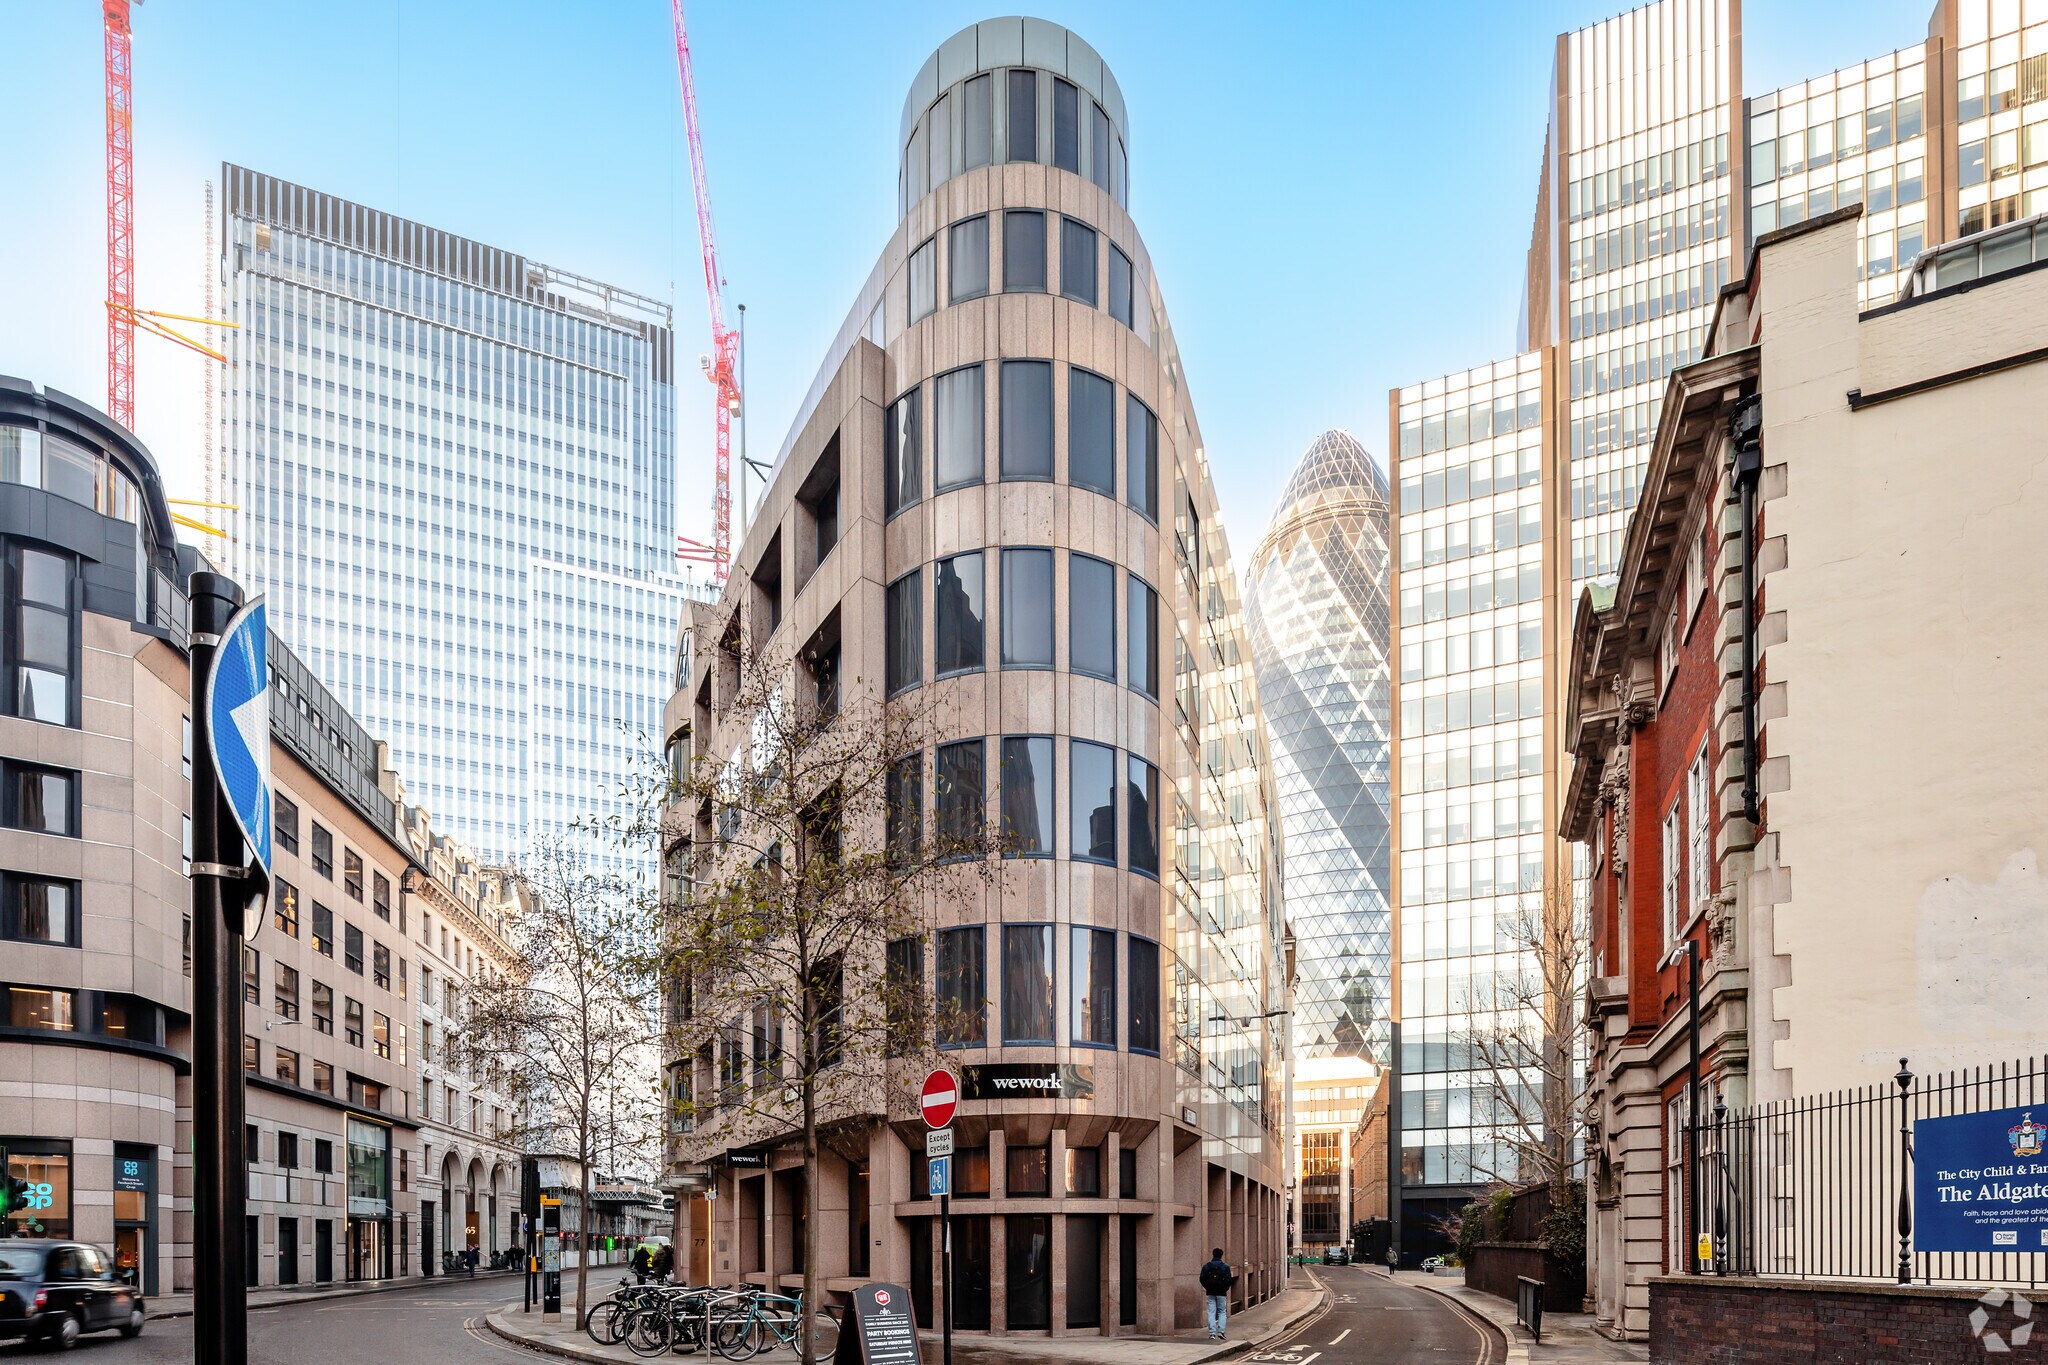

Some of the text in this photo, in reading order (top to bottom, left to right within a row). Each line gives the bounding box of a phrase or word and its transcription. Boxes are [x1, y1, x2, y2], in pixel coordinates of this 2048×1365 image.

[993, 1073, 1063, 1089] wework
[929, 1133, 950, 1143] Except
[929, 1143, 950, 1153] cycles
[731, 1155, 761, 1163] wework
[1937, 1170, 1957, 1181] The
[1959, 1169, 1981, 1181] City
[1983, 1166, 2013, 1177] Child
[2016, 1164, 2027, 1175] &
[1938, 1182, 2048, 1204] The Aldgate
[2001, 1216, 2029, 1225] greatest
[465, 1226, 476, 1235] 65
[694, 1238, 706, 1247] 77
